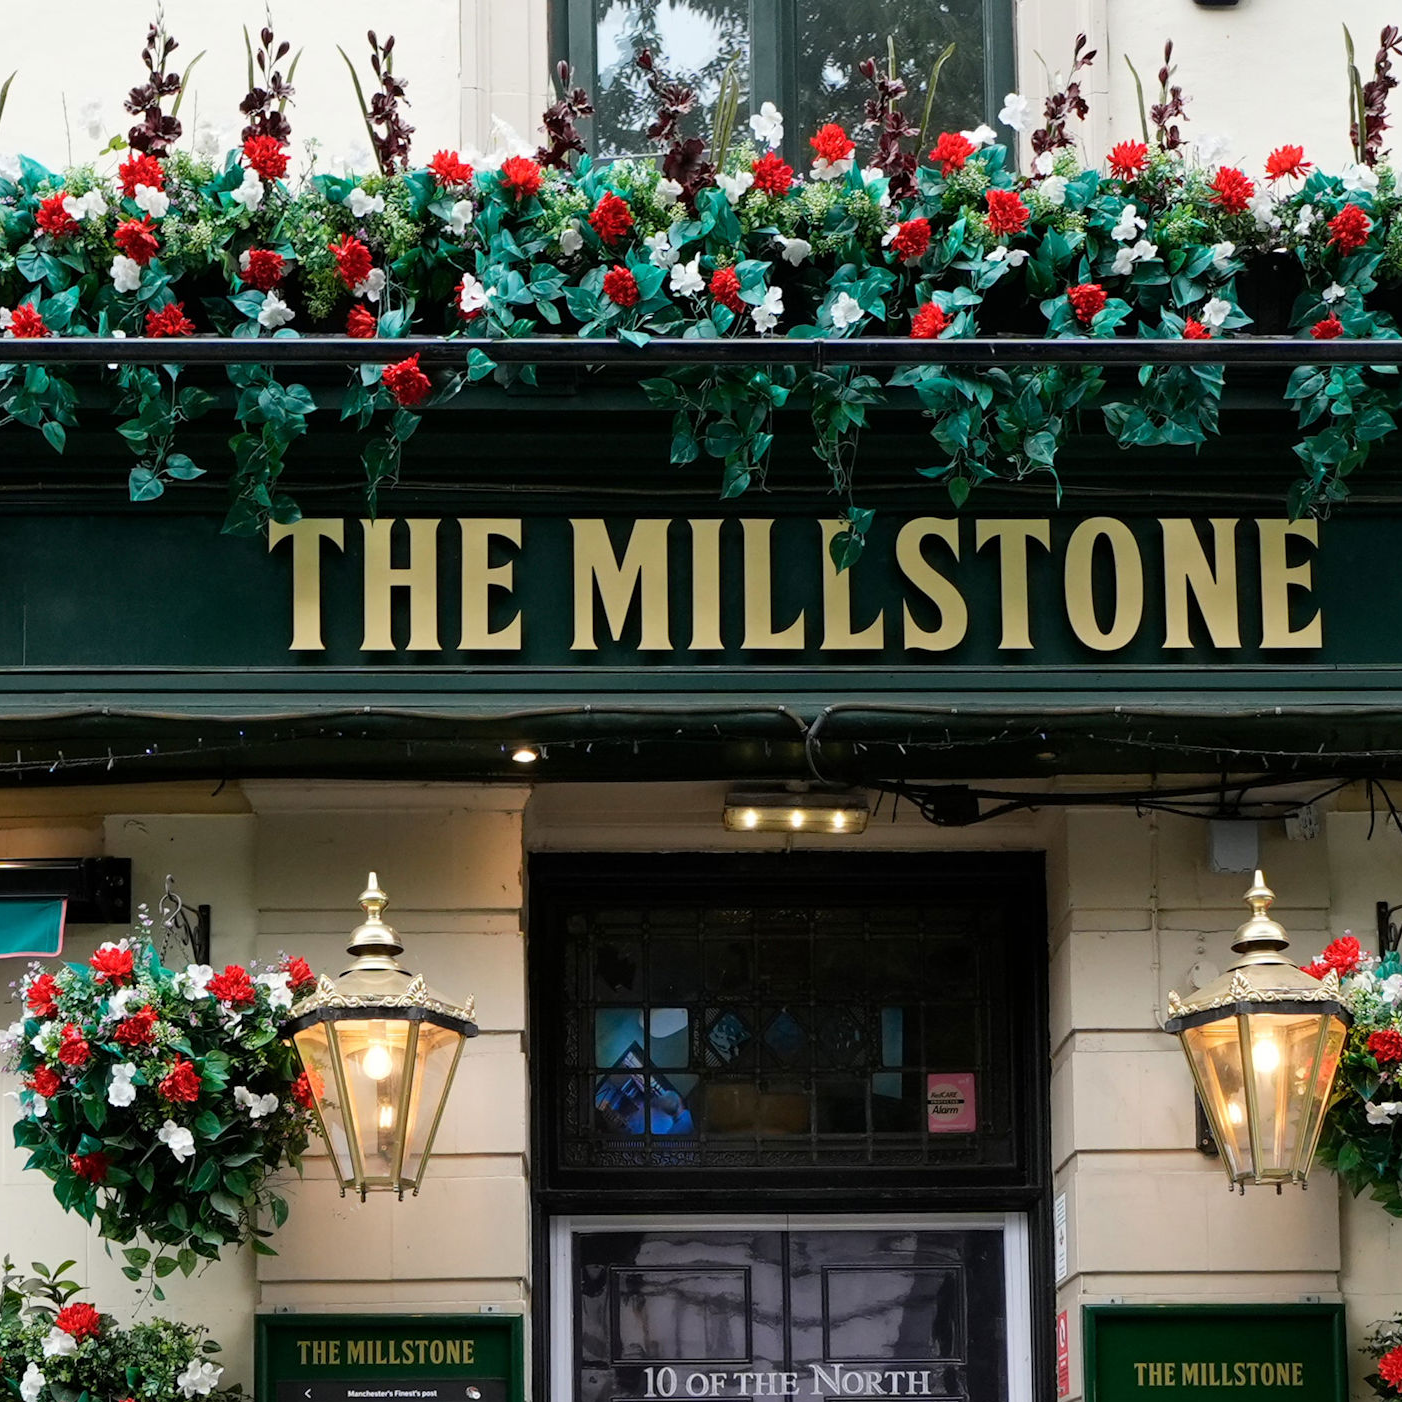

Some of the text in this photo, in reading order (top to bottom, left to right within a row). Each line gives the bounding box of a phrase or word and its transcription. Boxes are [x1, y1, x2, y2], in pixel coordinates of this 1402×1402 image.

[267, 516, 1323, 653] THE MILLSTONE
[932, 1106, 959, 1114] Alarm
[297, 1339, 475, 1365] THE MILLSTONE
[643, 1366, 677, 1398] 10
[1134, 1362, 1304, 1387] THE MILLSTONE
[347, 1390, 393, 1398] Manchester's
[421, 1390, 438, 1398] post
